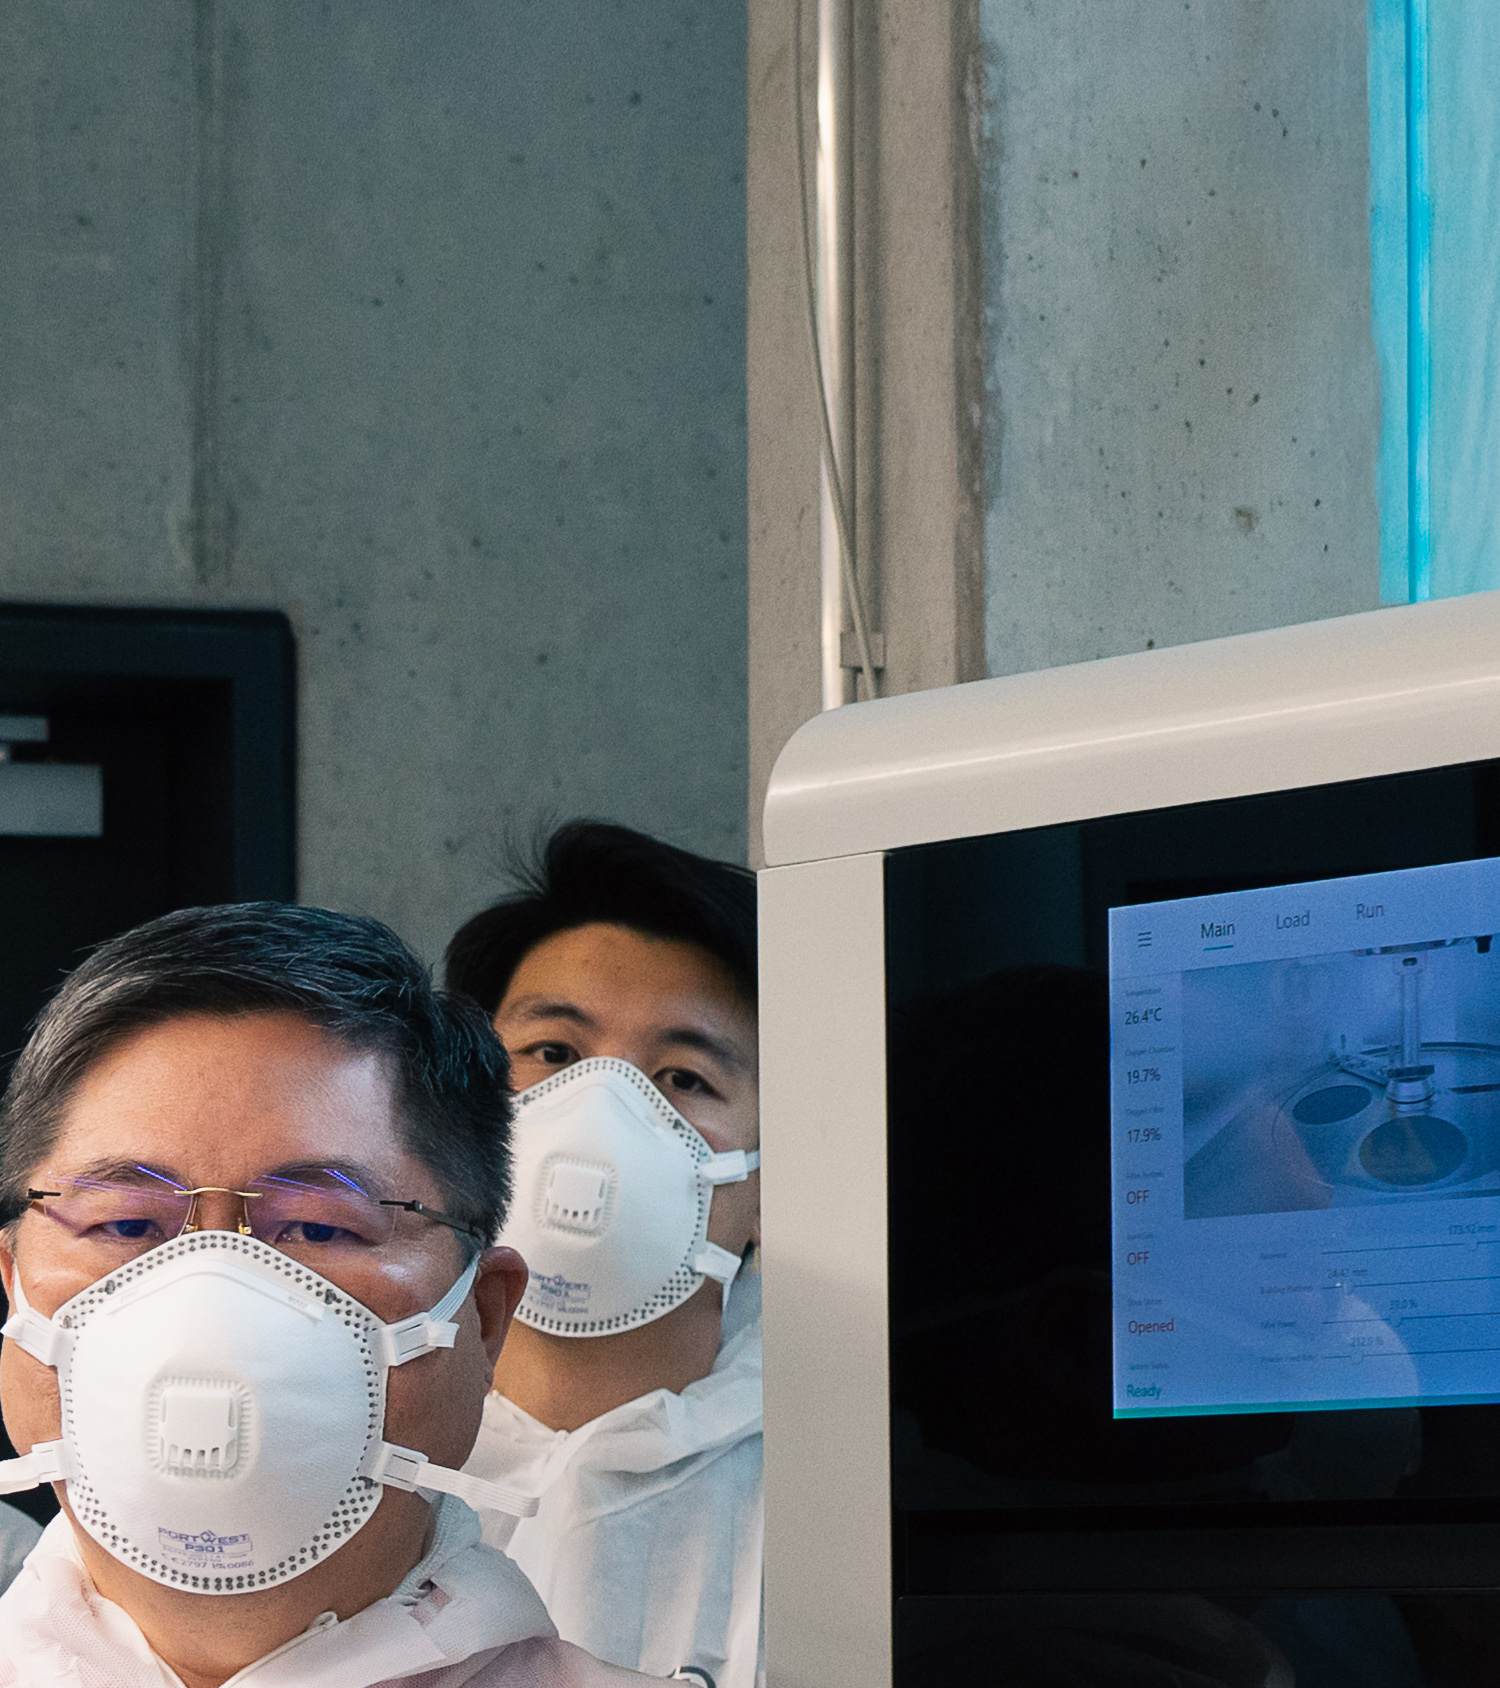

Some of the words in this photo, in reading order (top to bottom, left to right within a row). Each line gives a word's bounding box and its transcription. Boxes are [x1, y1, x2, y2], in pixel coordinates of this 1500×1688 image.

[1200, 921, 1235, 940] Main
[1276, 910, 1310, 930] Load
[1356, 903, 1385, 920] Run
[1127, 1068, 1161, 1085] 19.7%
[1127, 1128, 1161, 1143] 17.9%
[1126, 1190, 1149, 1205] OFF
[1126, 1251, 1150, 1266] OFF
[1128, 1319, 1175, 1336] Opened
[1126, 1384, 1162, 1400] Ready
